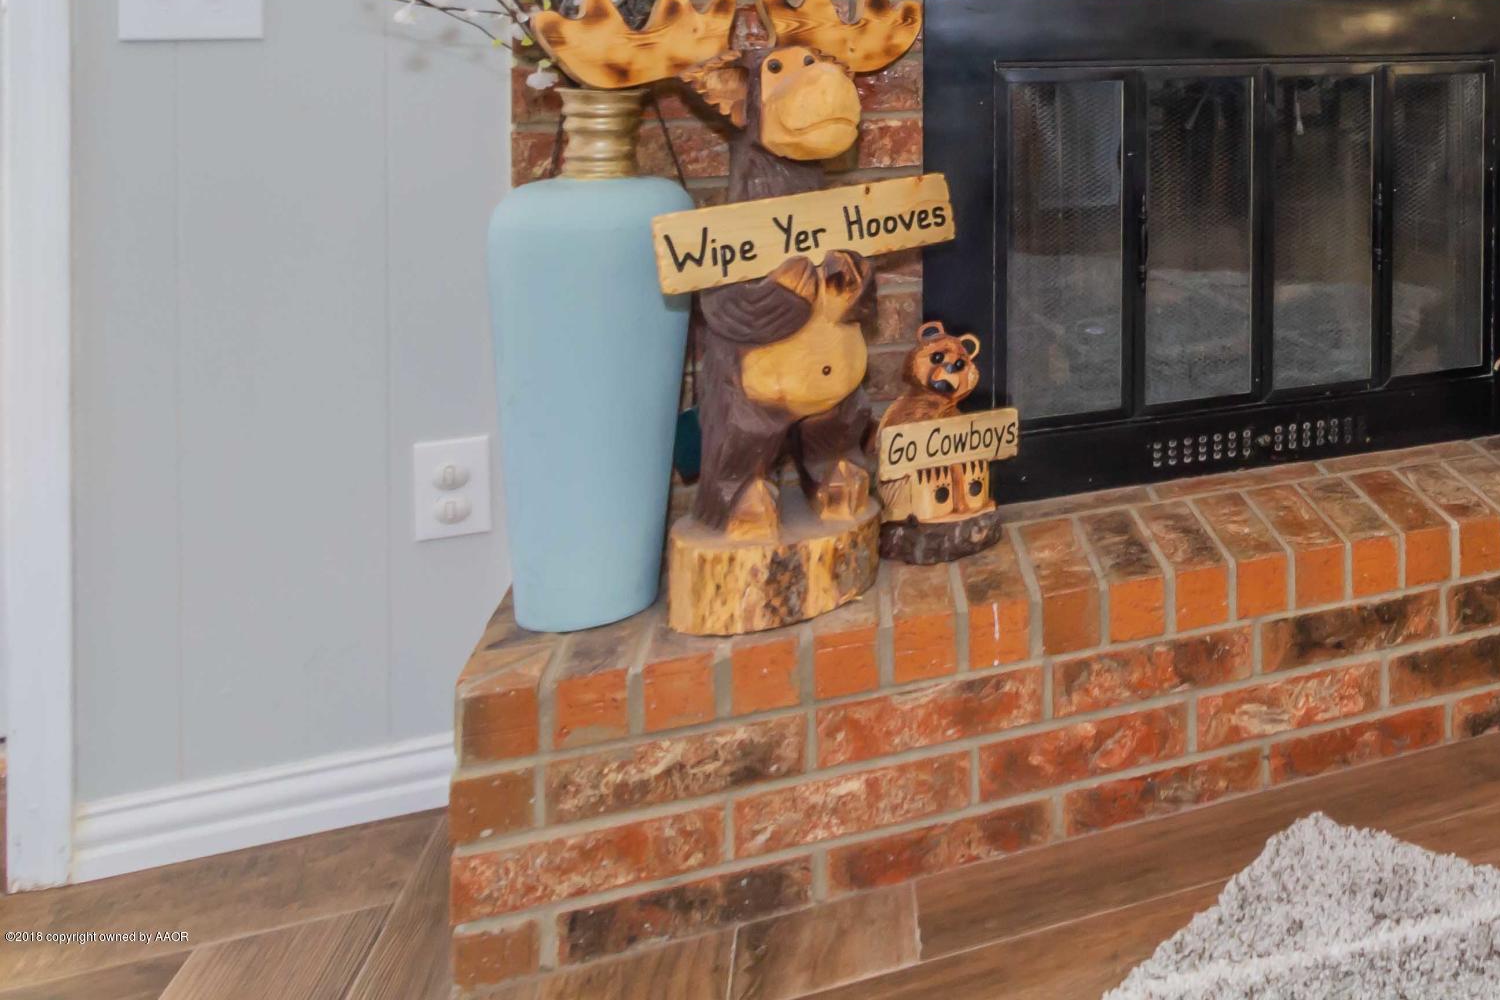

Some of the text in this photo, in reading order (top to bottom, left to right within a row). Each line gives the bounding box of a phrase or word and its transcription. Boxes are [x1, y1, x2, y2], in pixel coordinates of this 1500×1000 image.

[663, 205, 947, 278] Wipe Yer Hooves
[888, 420, 1017, 466] Go Cowboys
